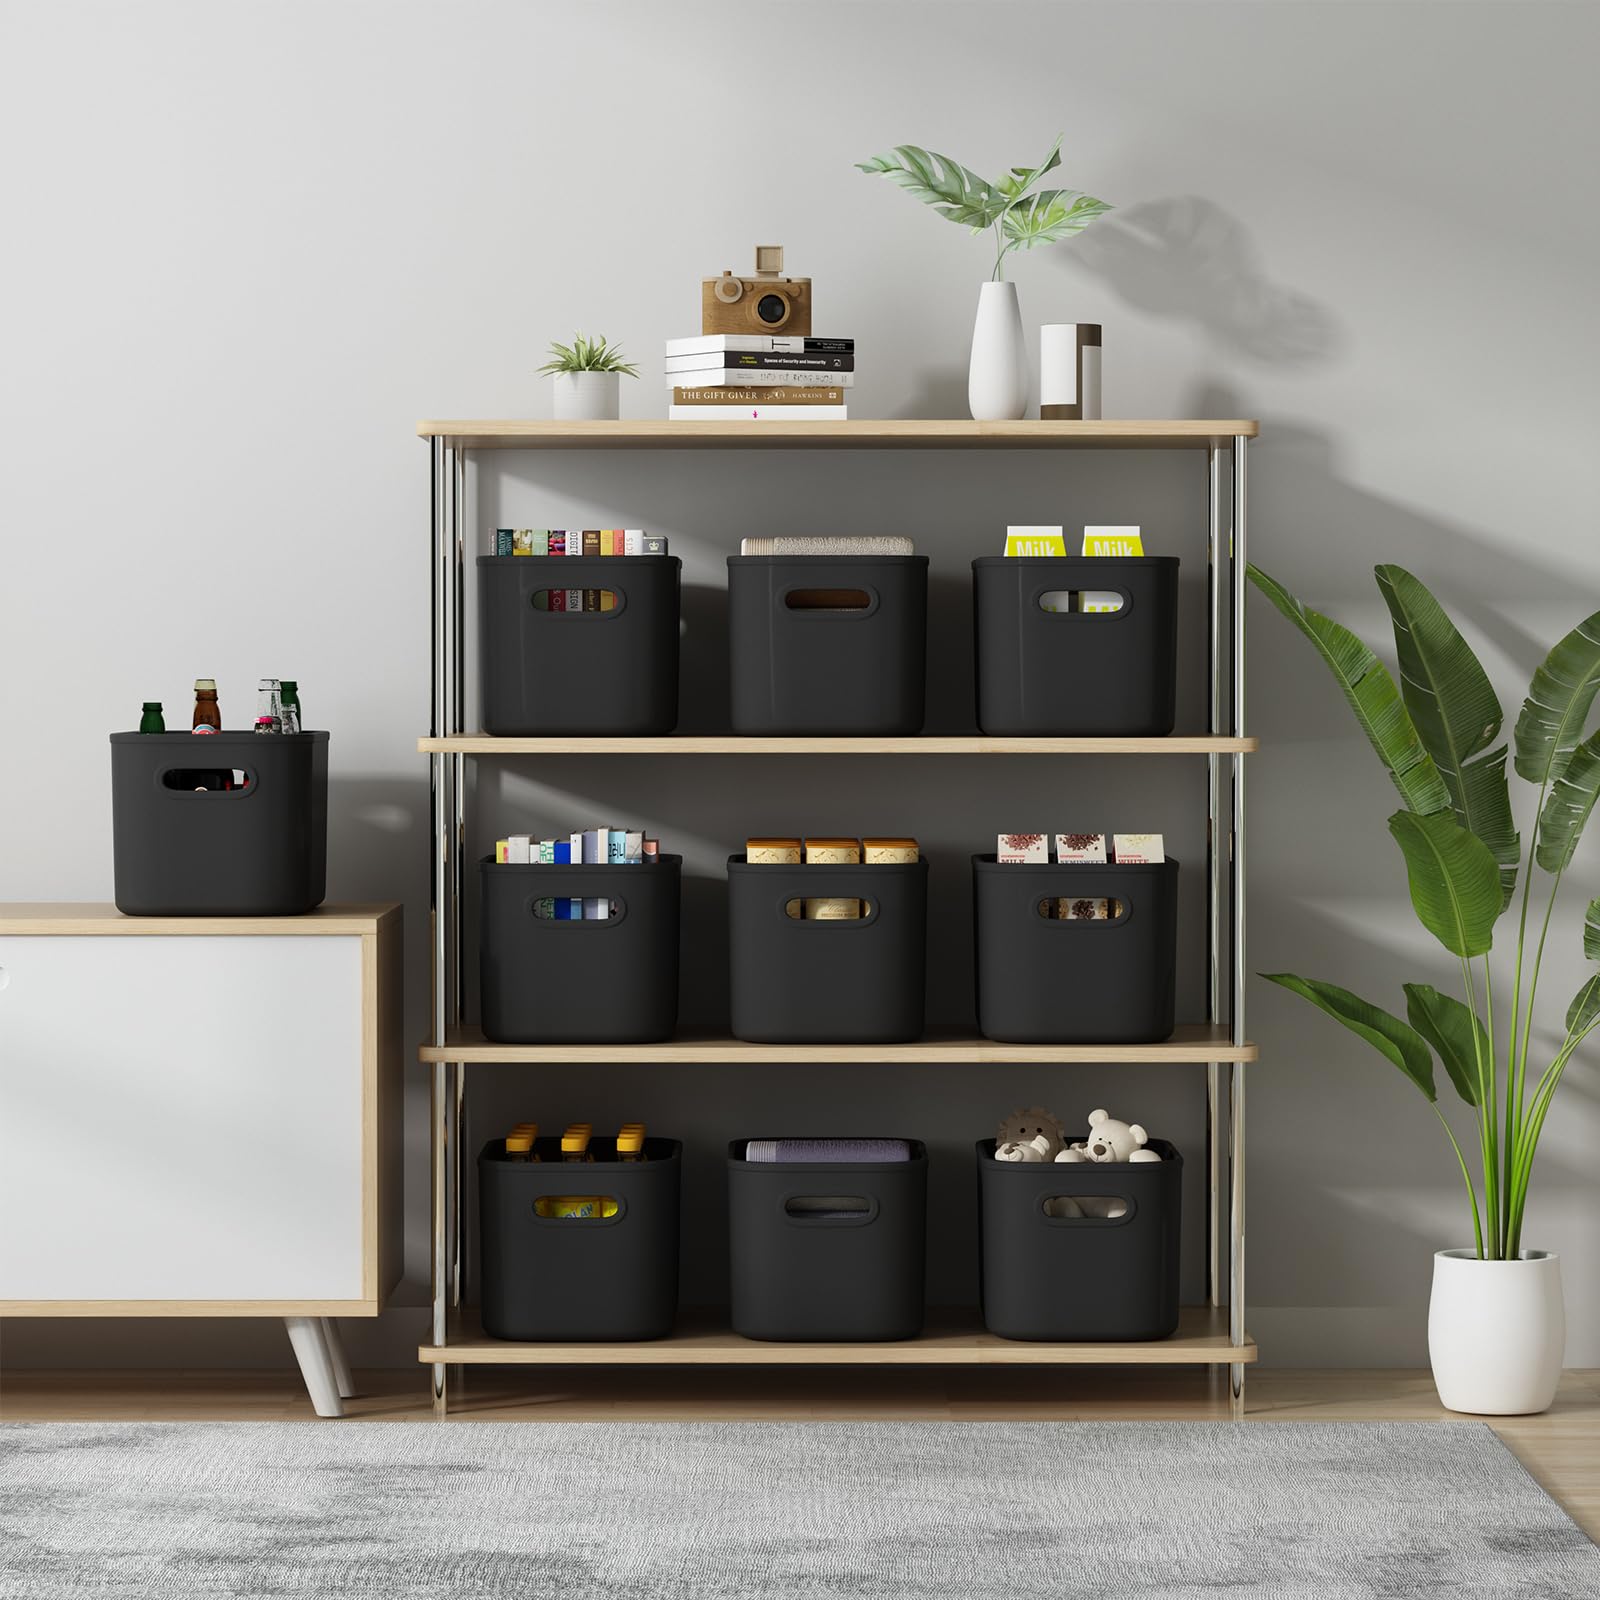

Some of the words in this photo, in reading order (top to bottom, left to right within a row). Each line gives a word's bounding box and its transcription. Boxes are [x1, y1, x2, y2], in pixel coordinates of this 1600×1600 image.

[681, 391, 700, 399] THE
[703, 391, 726, 399] GIFT
[728, 391, 757, 399] GIVER
[1015, 541, 1055, 556] Milk
[1093, 541, 1133, 556] Milk
